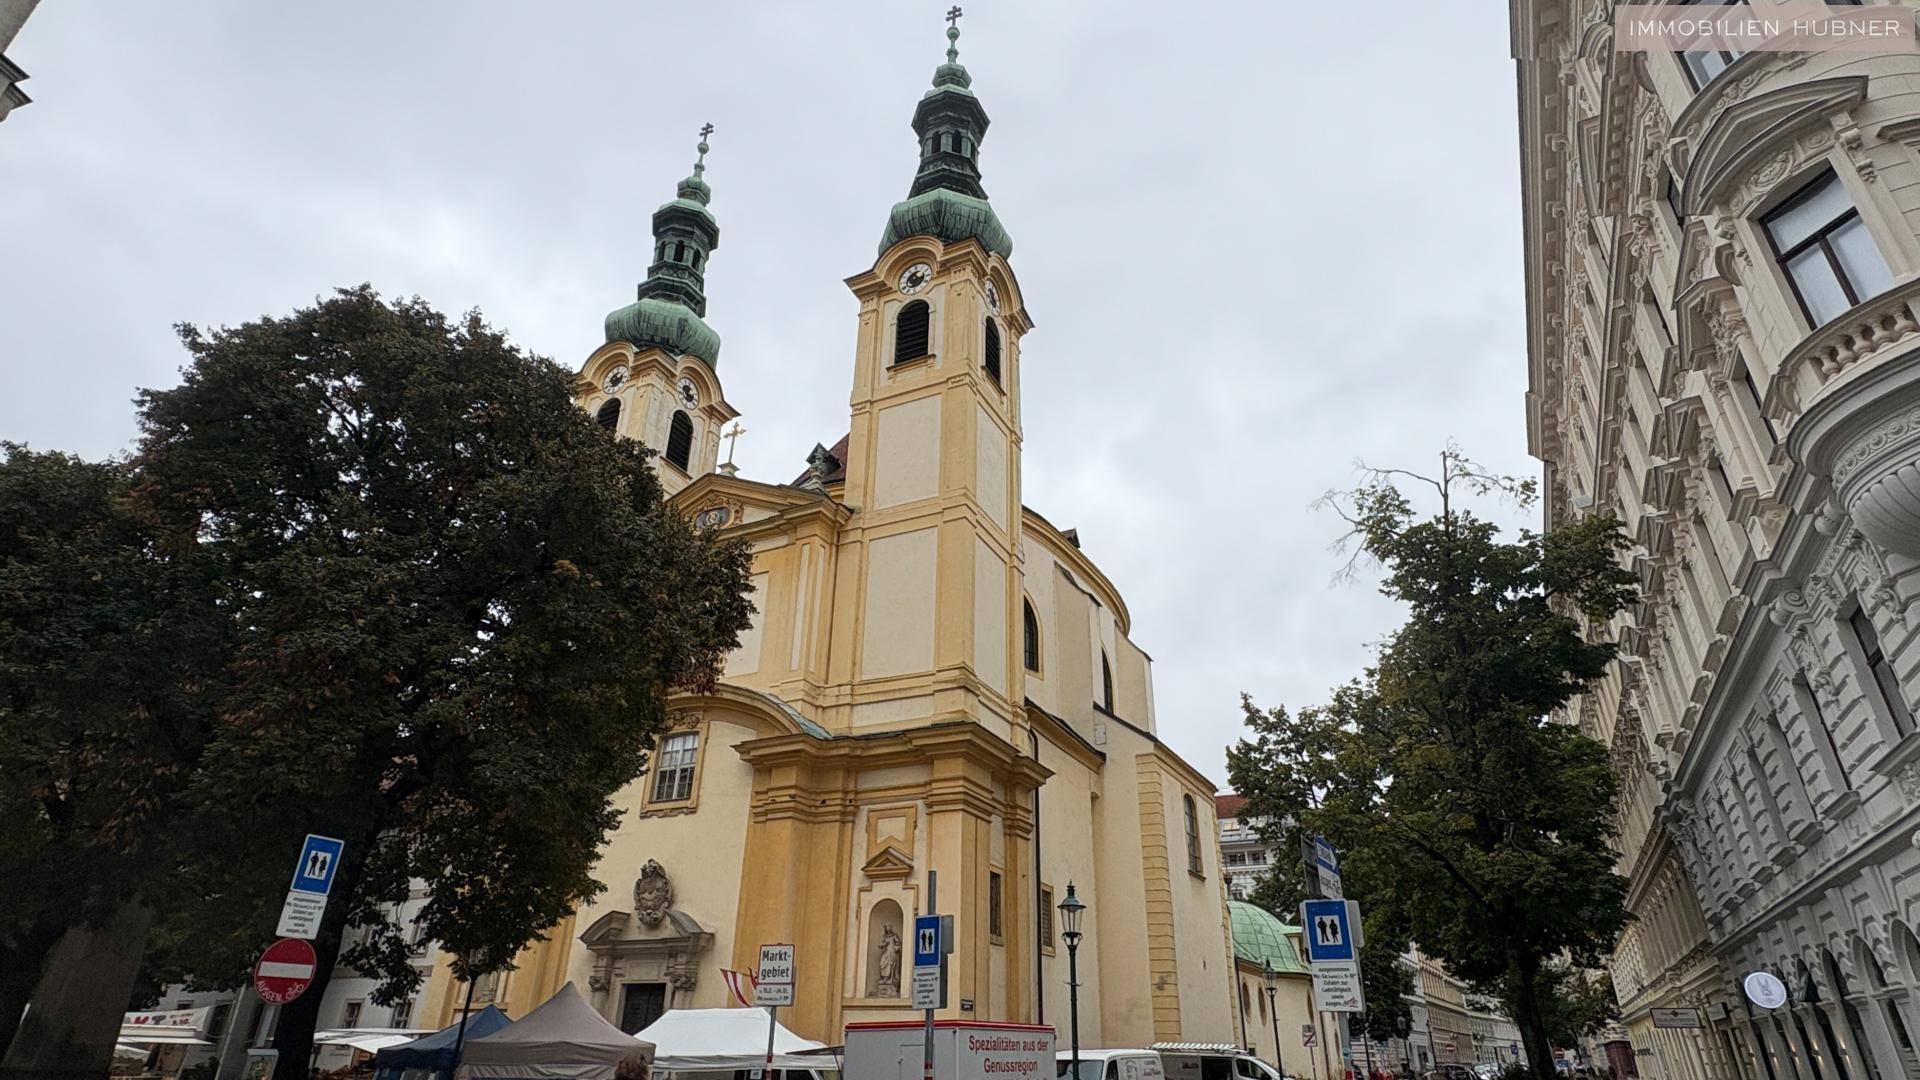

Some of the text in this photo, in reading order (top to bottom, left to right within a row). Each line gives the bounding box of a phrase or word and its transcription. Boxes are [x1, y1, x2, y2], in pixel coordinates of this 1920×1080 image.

[762, 950, 792, 961] Markt-
[761, 965, 790, 980] gebiet
[968, 1034, 1049, 1055] Spezialitäten aus der
[983, 1057, 1038, 1075] Genussregion
